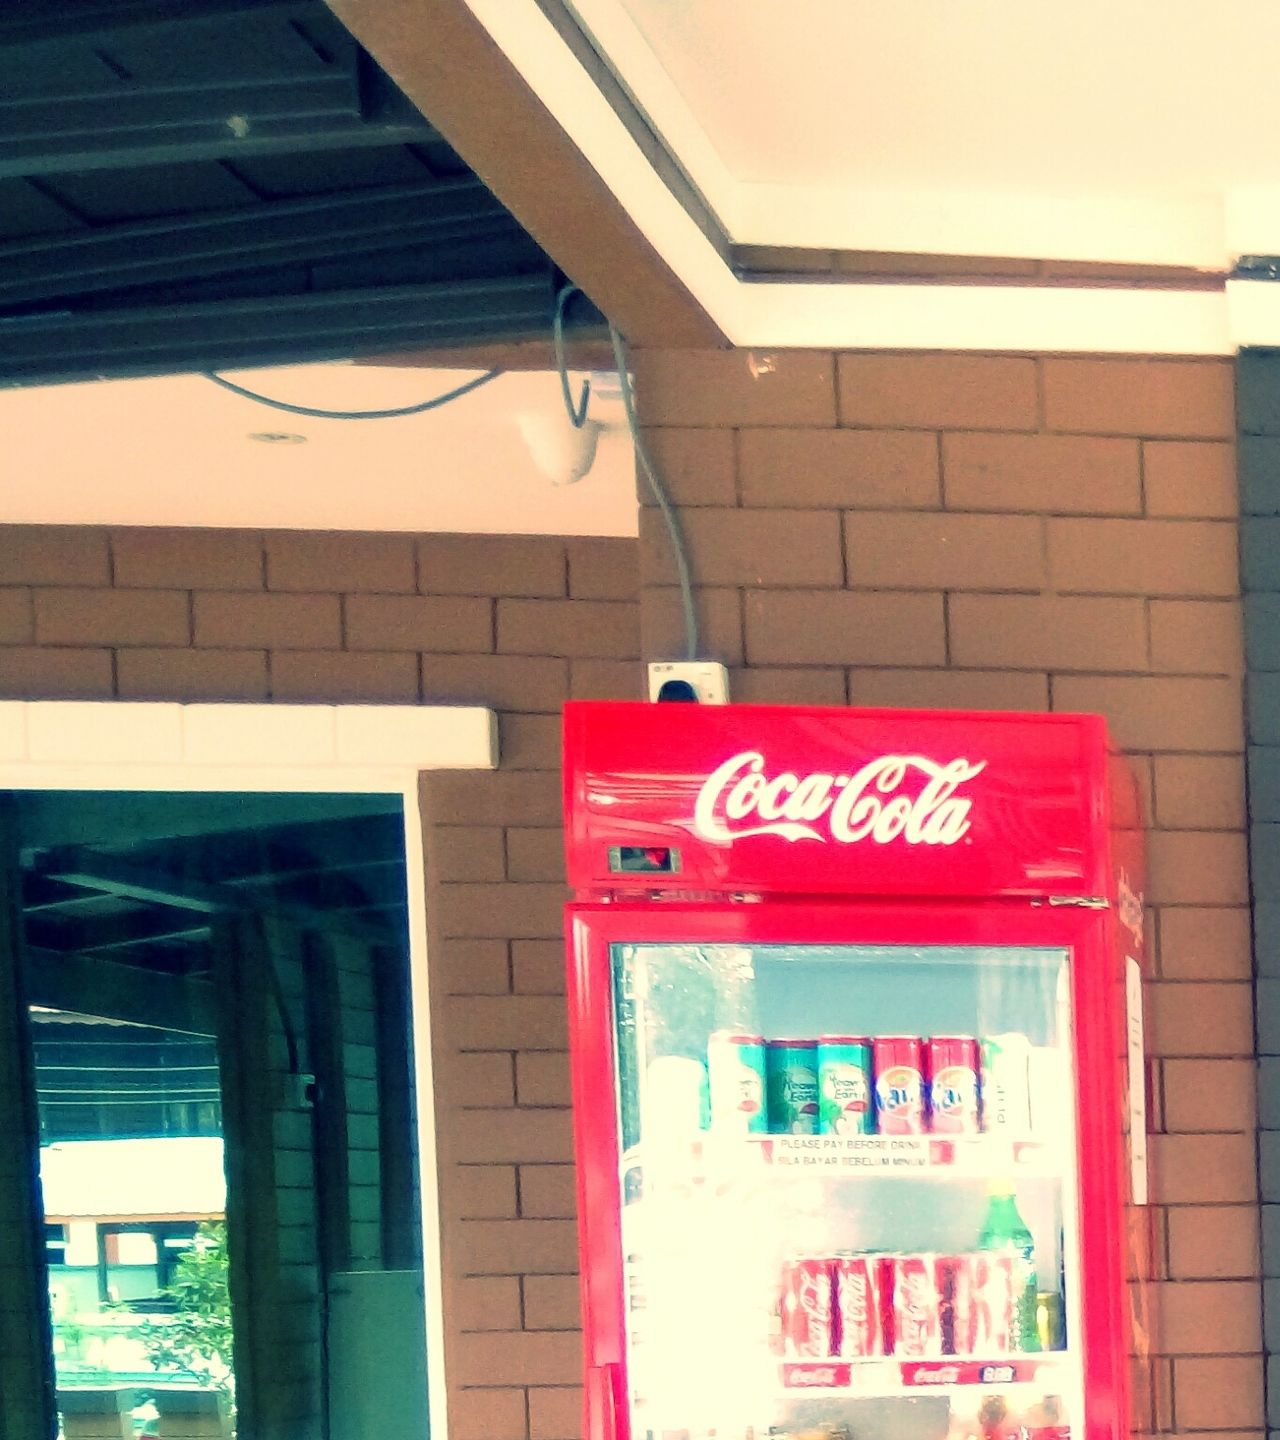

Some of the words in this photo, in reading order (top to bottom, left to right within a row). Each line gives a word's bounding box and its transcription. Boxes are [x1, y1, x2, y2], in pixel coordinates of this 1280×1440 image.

[694, 751, 987, 844] Coca-Cola
[780, 1139, 820, 1149] PLEASE
[823, 1140, 843, 1149] PAY
[847, 1140, 887, 1149] BEFORE
